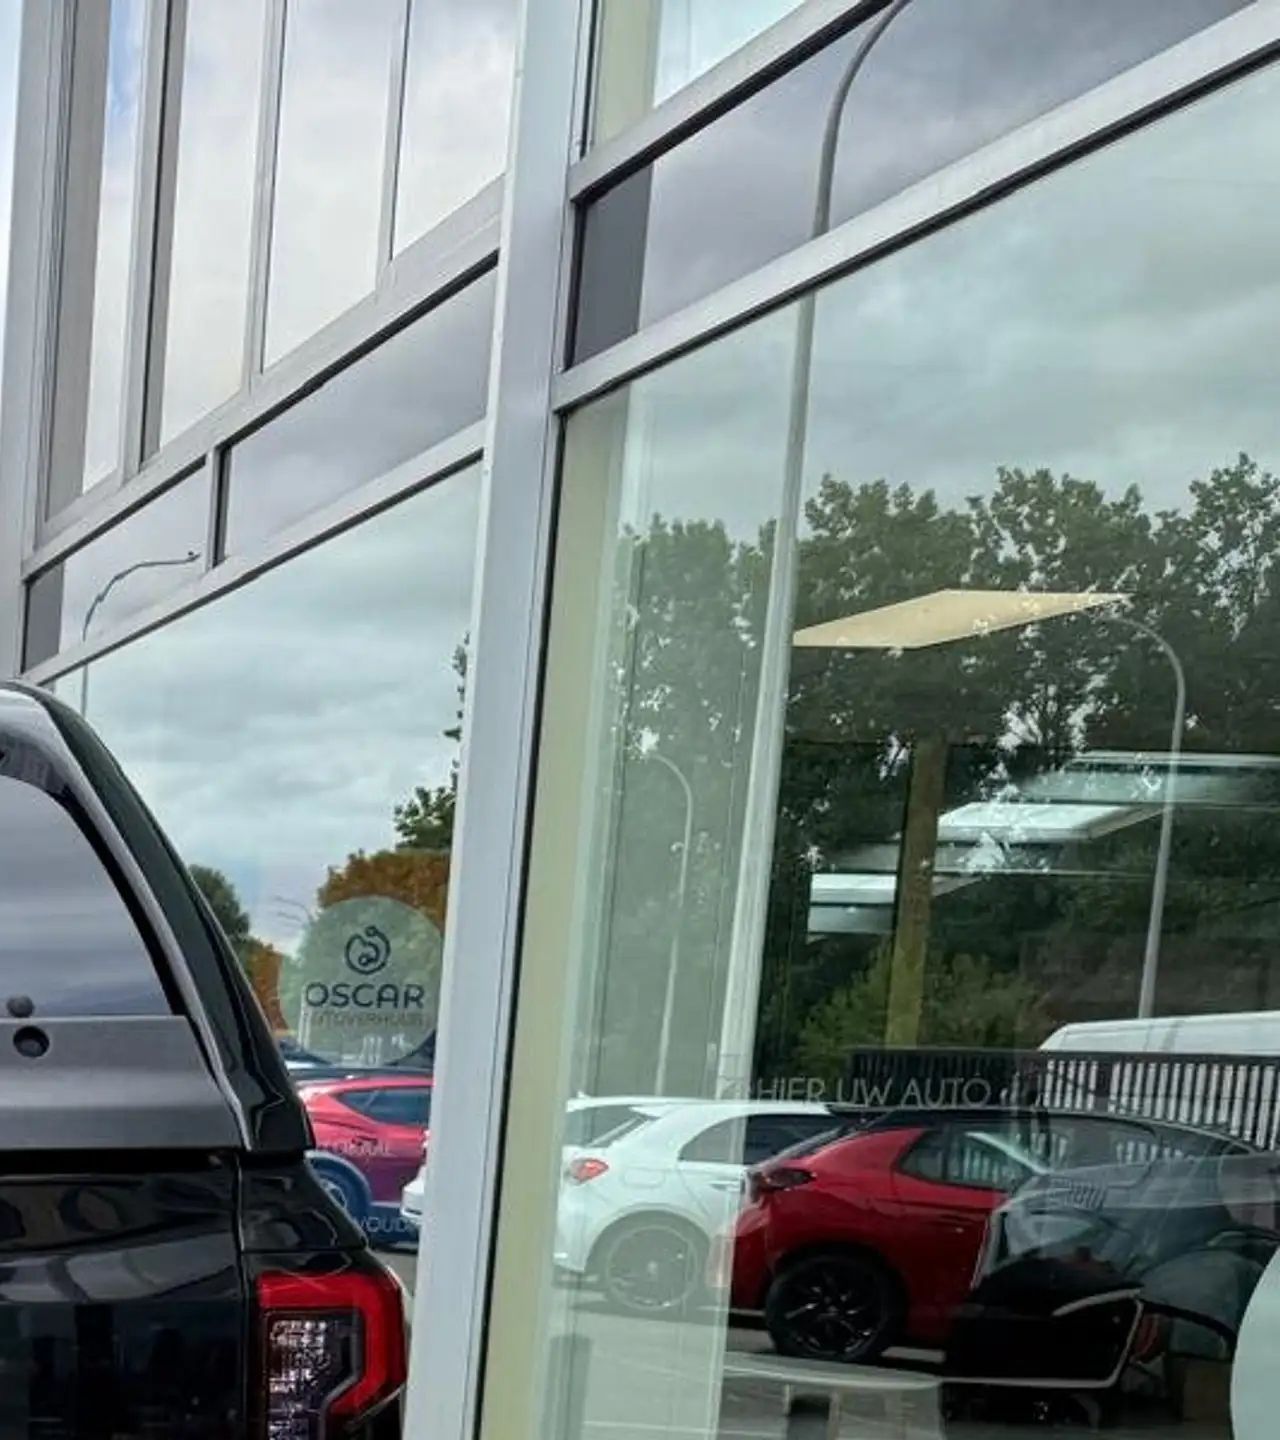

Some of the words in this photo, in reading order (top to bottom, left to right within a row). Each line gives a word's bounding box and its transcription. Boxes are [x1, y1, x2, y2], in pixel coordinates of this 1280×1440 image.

[305, 982, 425, 1008] OSCAR
[756, 1076, 825, 1106] HIER
[836, 1077, 893, 1107] UW
[900, 1076, 991, 1108] AUTO
